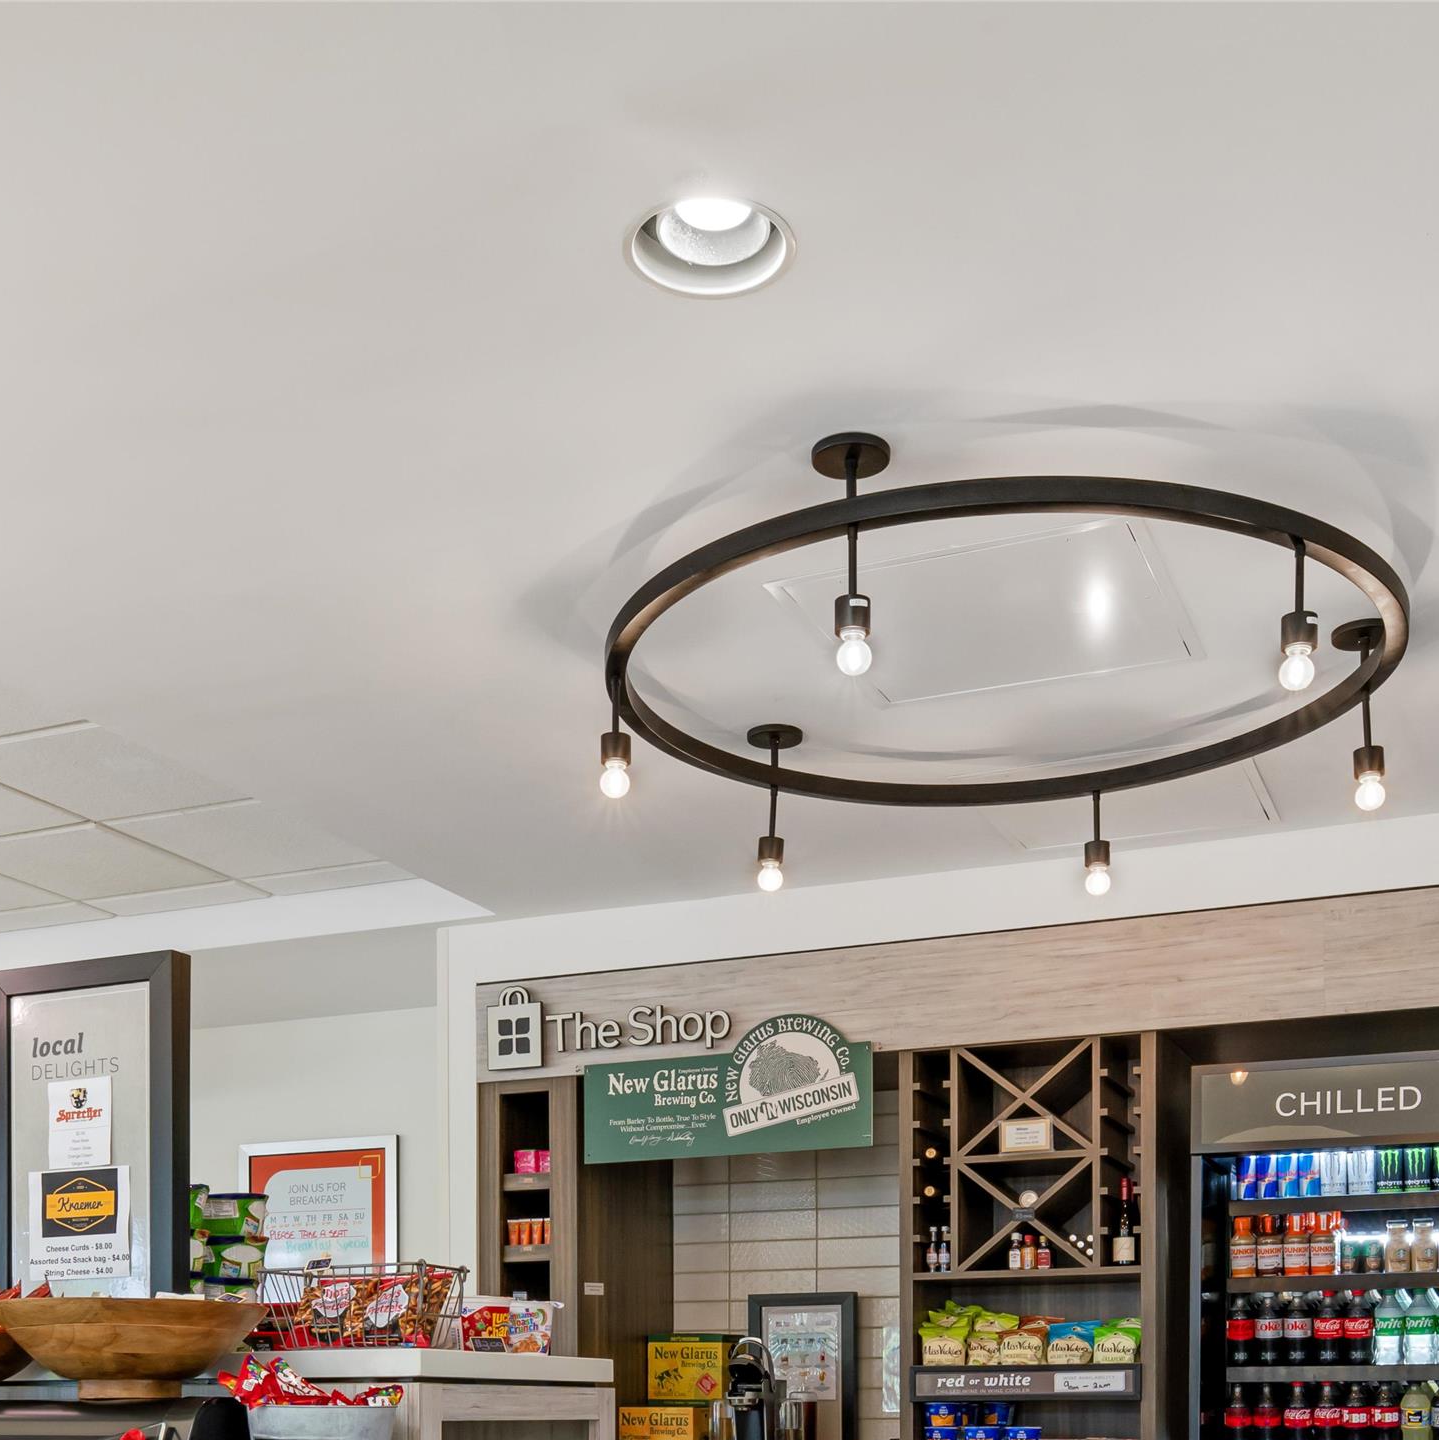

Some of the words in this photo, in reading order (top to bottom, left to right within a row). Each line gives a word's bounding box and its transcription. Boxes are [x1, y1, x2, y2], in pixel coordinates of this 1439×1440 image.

[545, 1012, 622, 1052] The
[627, 1005, 731, 1048] Shop
[32, 1032, 84, 1058] local
[725, 1066, 740, 1103] New
[733, 1023, 775, 1065] Glarus
[777, 1016, 840, 1047] Brewing
[31, 1057, 119, 1081] DELIGHTS
[607, 1072, 650, 1096] New
[652, 1069, 718, 1092] Glarus
[654, 1092, 696, 1108] Brewing
[699, 1091, 716, 1104] Co.
[730, 1106, 761, 1128] ONLY
[778, 1081, 852, 1115] WISCONSIN
[1275, 1085, 1422, 1117] CHILLED
[796, 1111, 830, 1126] Employee
[830, 1103, 856, 1116] Owned
[288, 1184, 309, 1194] JOIN
[311, 1183, 324, 1193] US
[327, 1182, 346, 1192] FOR
[57, 1197, 103, 1212] Kraemer
[289, 1194, 344, 1206] BREAKFAST
[46, 1245, 69, 1253] Cheese
[71, 1244, 90, 1252] Curds
[95, 1242, 112, 1250] $8.00
[30, 1257, 59, 1265] Assorted
[73, 1256, 92, 1264] Snack
[94, 1255, 106, 1264] bag
[45, 1269, 64, 1278] String
[66, 1267, 90, 1275] Cheese
[1405, 1317, 1433, 1329] Sprite
[654, 1346, 678, 1360] New
[680, 1346, 718, 1360] Glarus
[936, 1374, 965, 1388] red
[984, 1374, 1031, 1388] white
[621, 1412, 646, 1427] New
[649, 1412, 689, 1427] Glarus
[649, 1427, 675, 1437] Brewing
